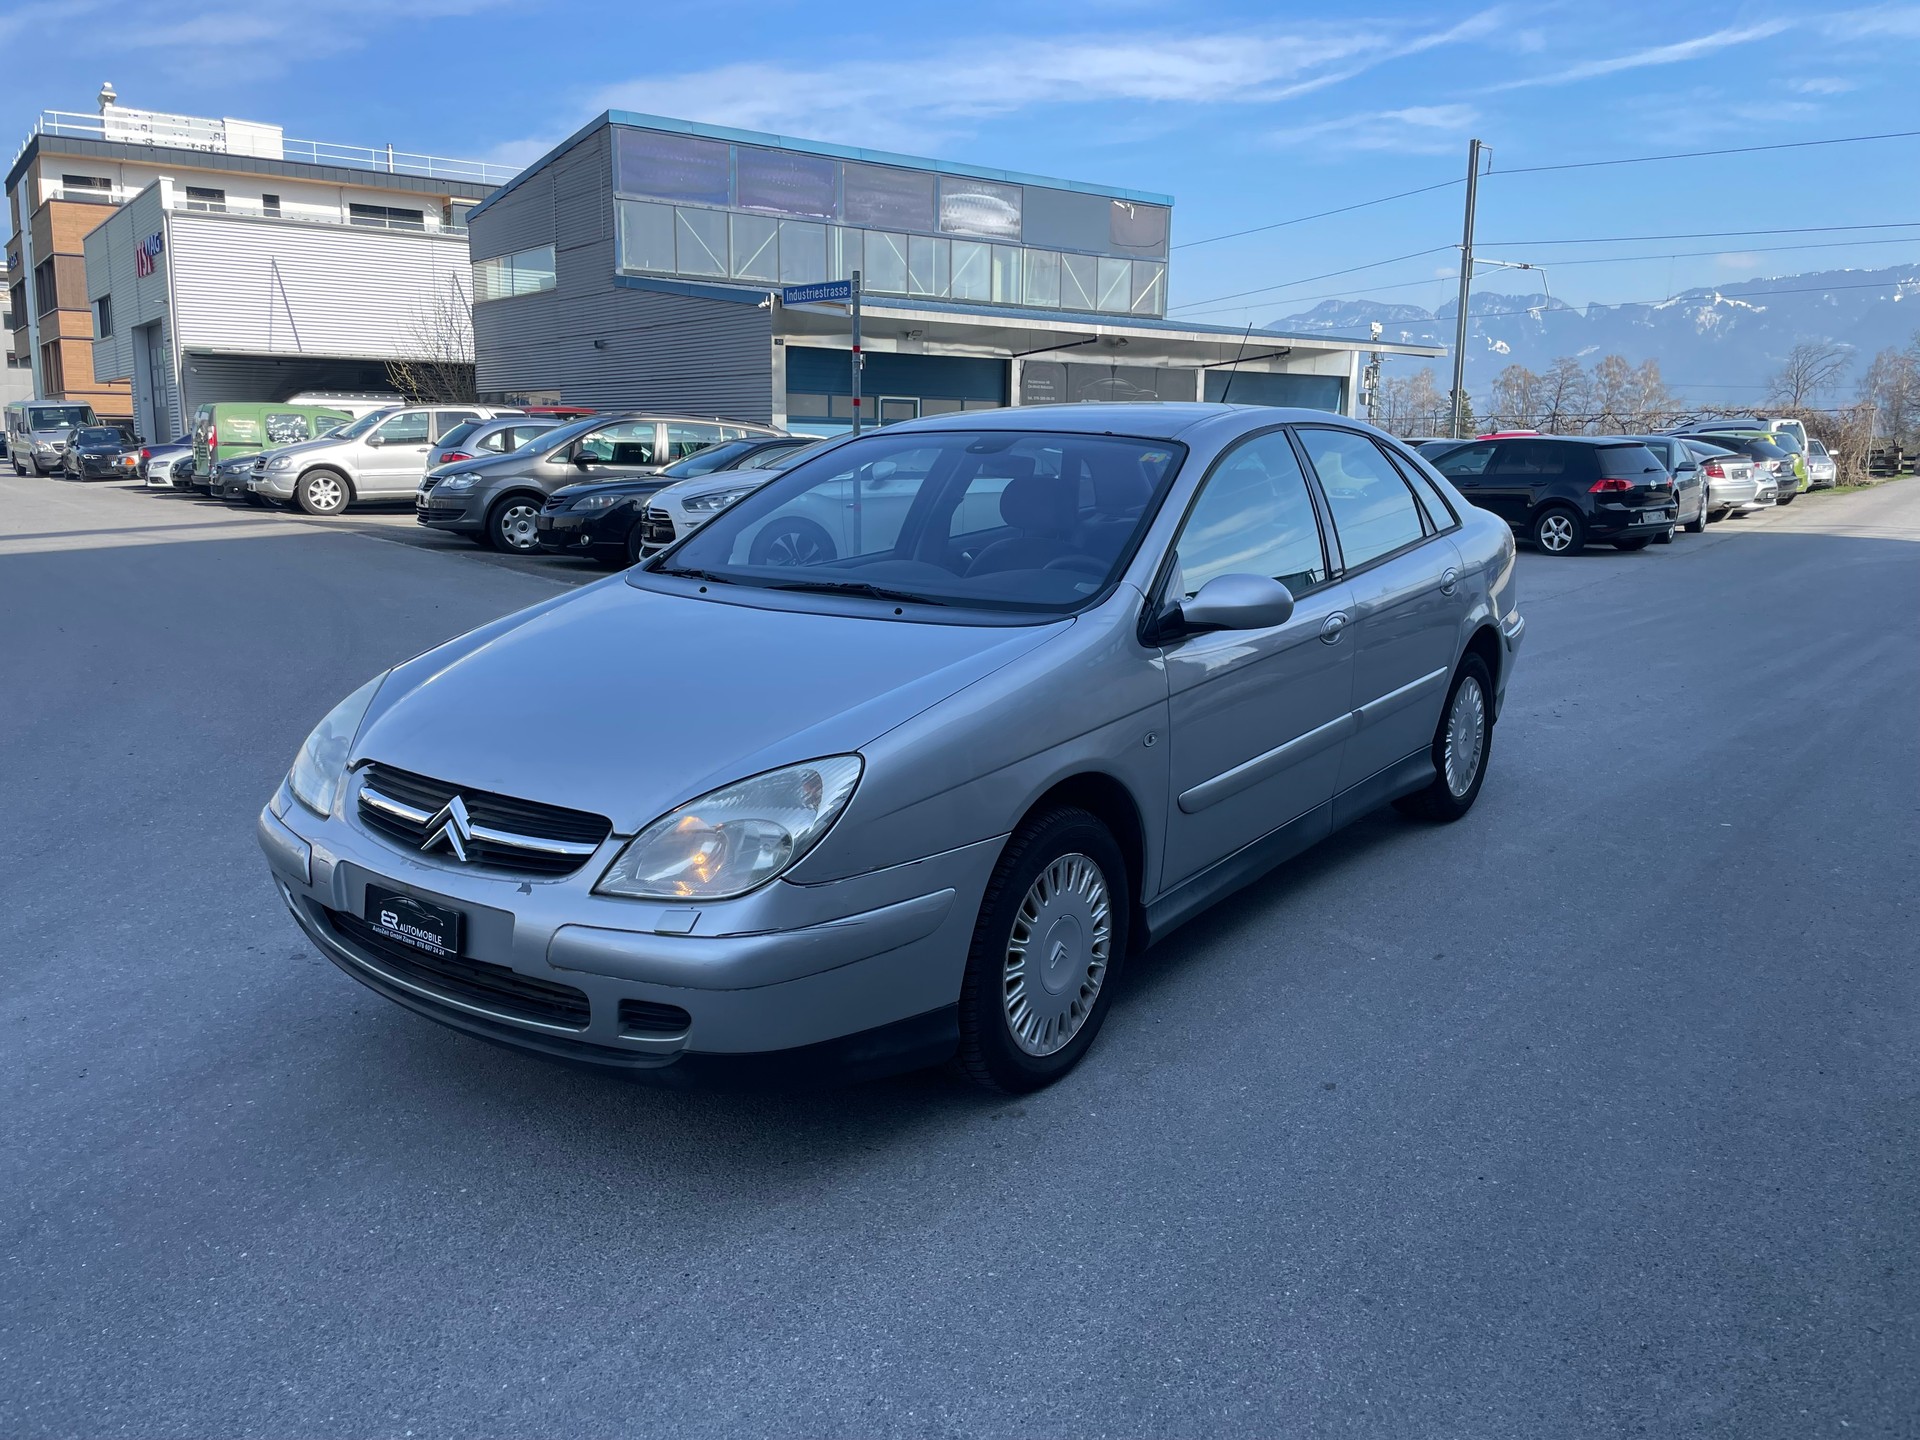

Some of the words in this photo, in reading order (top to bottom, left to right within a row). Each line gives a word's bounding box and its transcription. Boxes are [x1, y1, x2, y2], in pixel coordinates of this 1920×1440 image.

[786, 286, 848, 302] Industriestrasse
[389, 931, 403, 940] GmbH
[399, 923, 443, 945] AUTOMOBILE
